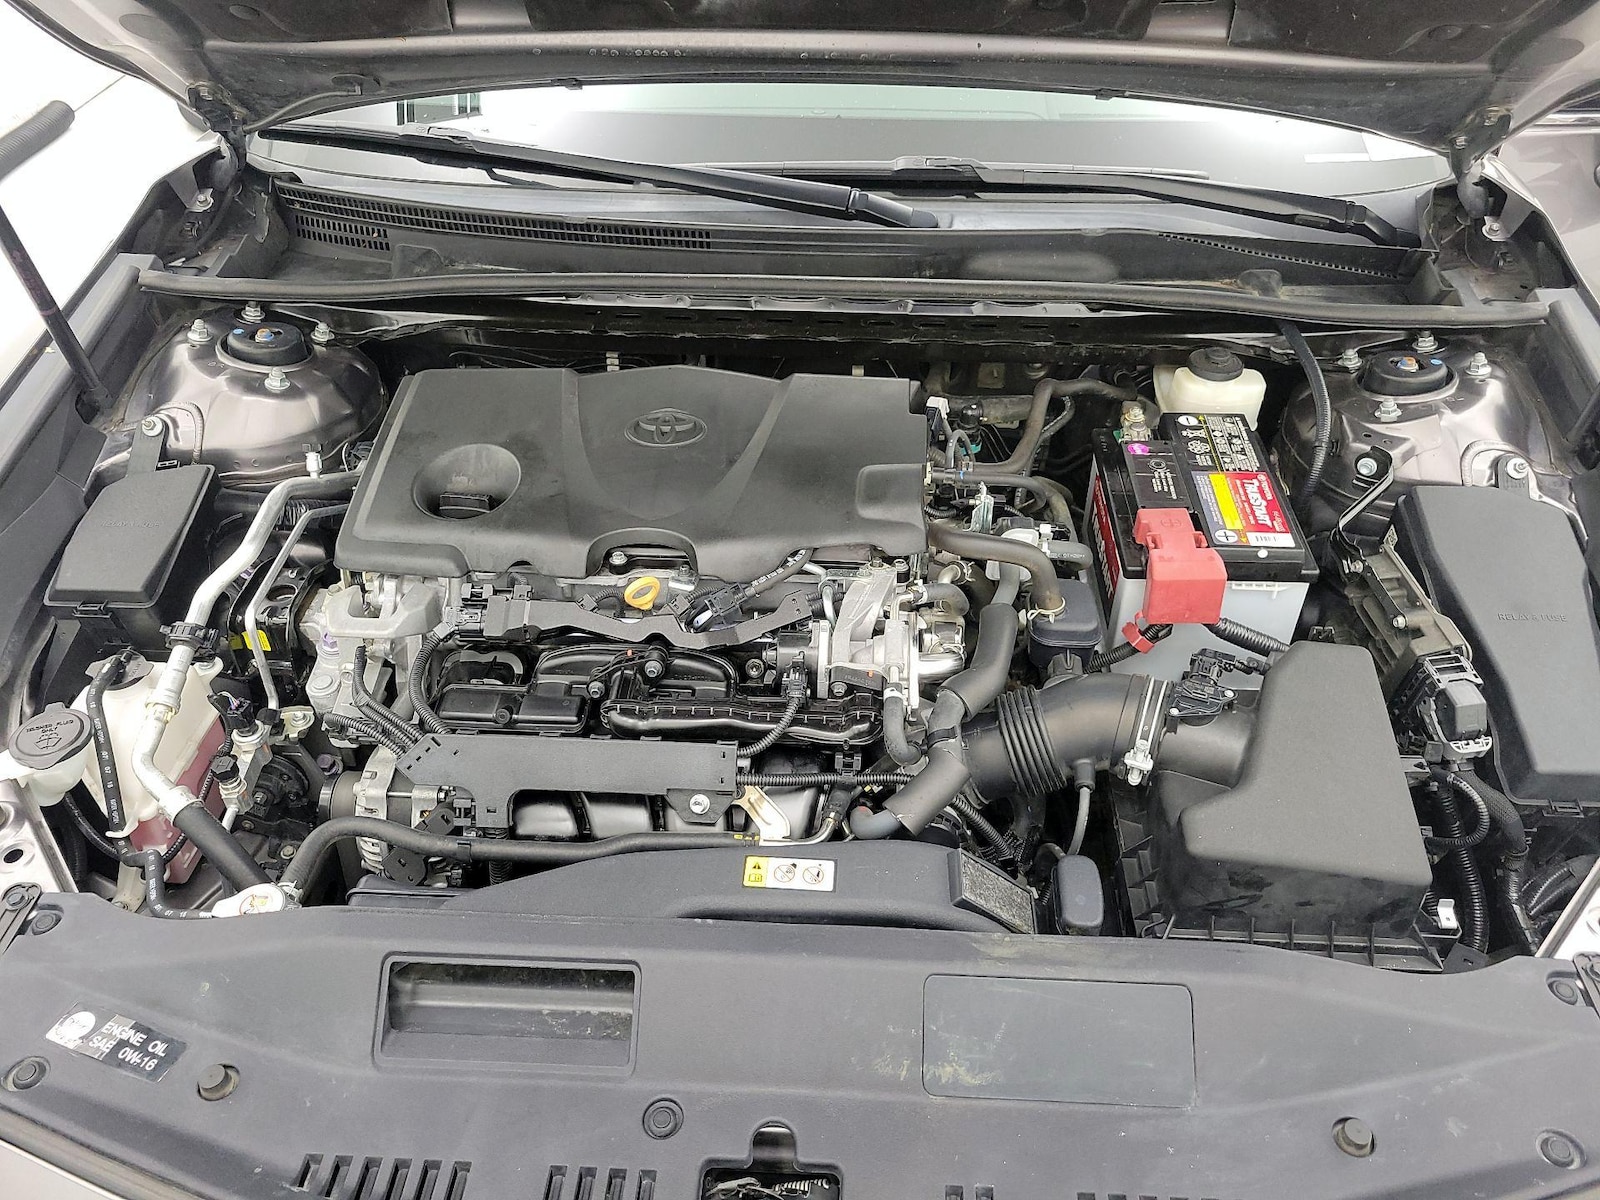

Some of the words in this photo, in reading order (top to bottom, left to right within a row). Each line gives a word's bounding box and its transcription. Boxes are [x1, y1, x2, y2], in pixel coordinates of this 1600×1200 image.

[1497, 612, 1529, 621] RELAY
[88, 1035, 119, 1053] SAE
[117, 1046, 158, 1071] 0W-16
[101, 1022, 148, 1047] ENGINE
[148, 1039, 170, 1057] OIL
